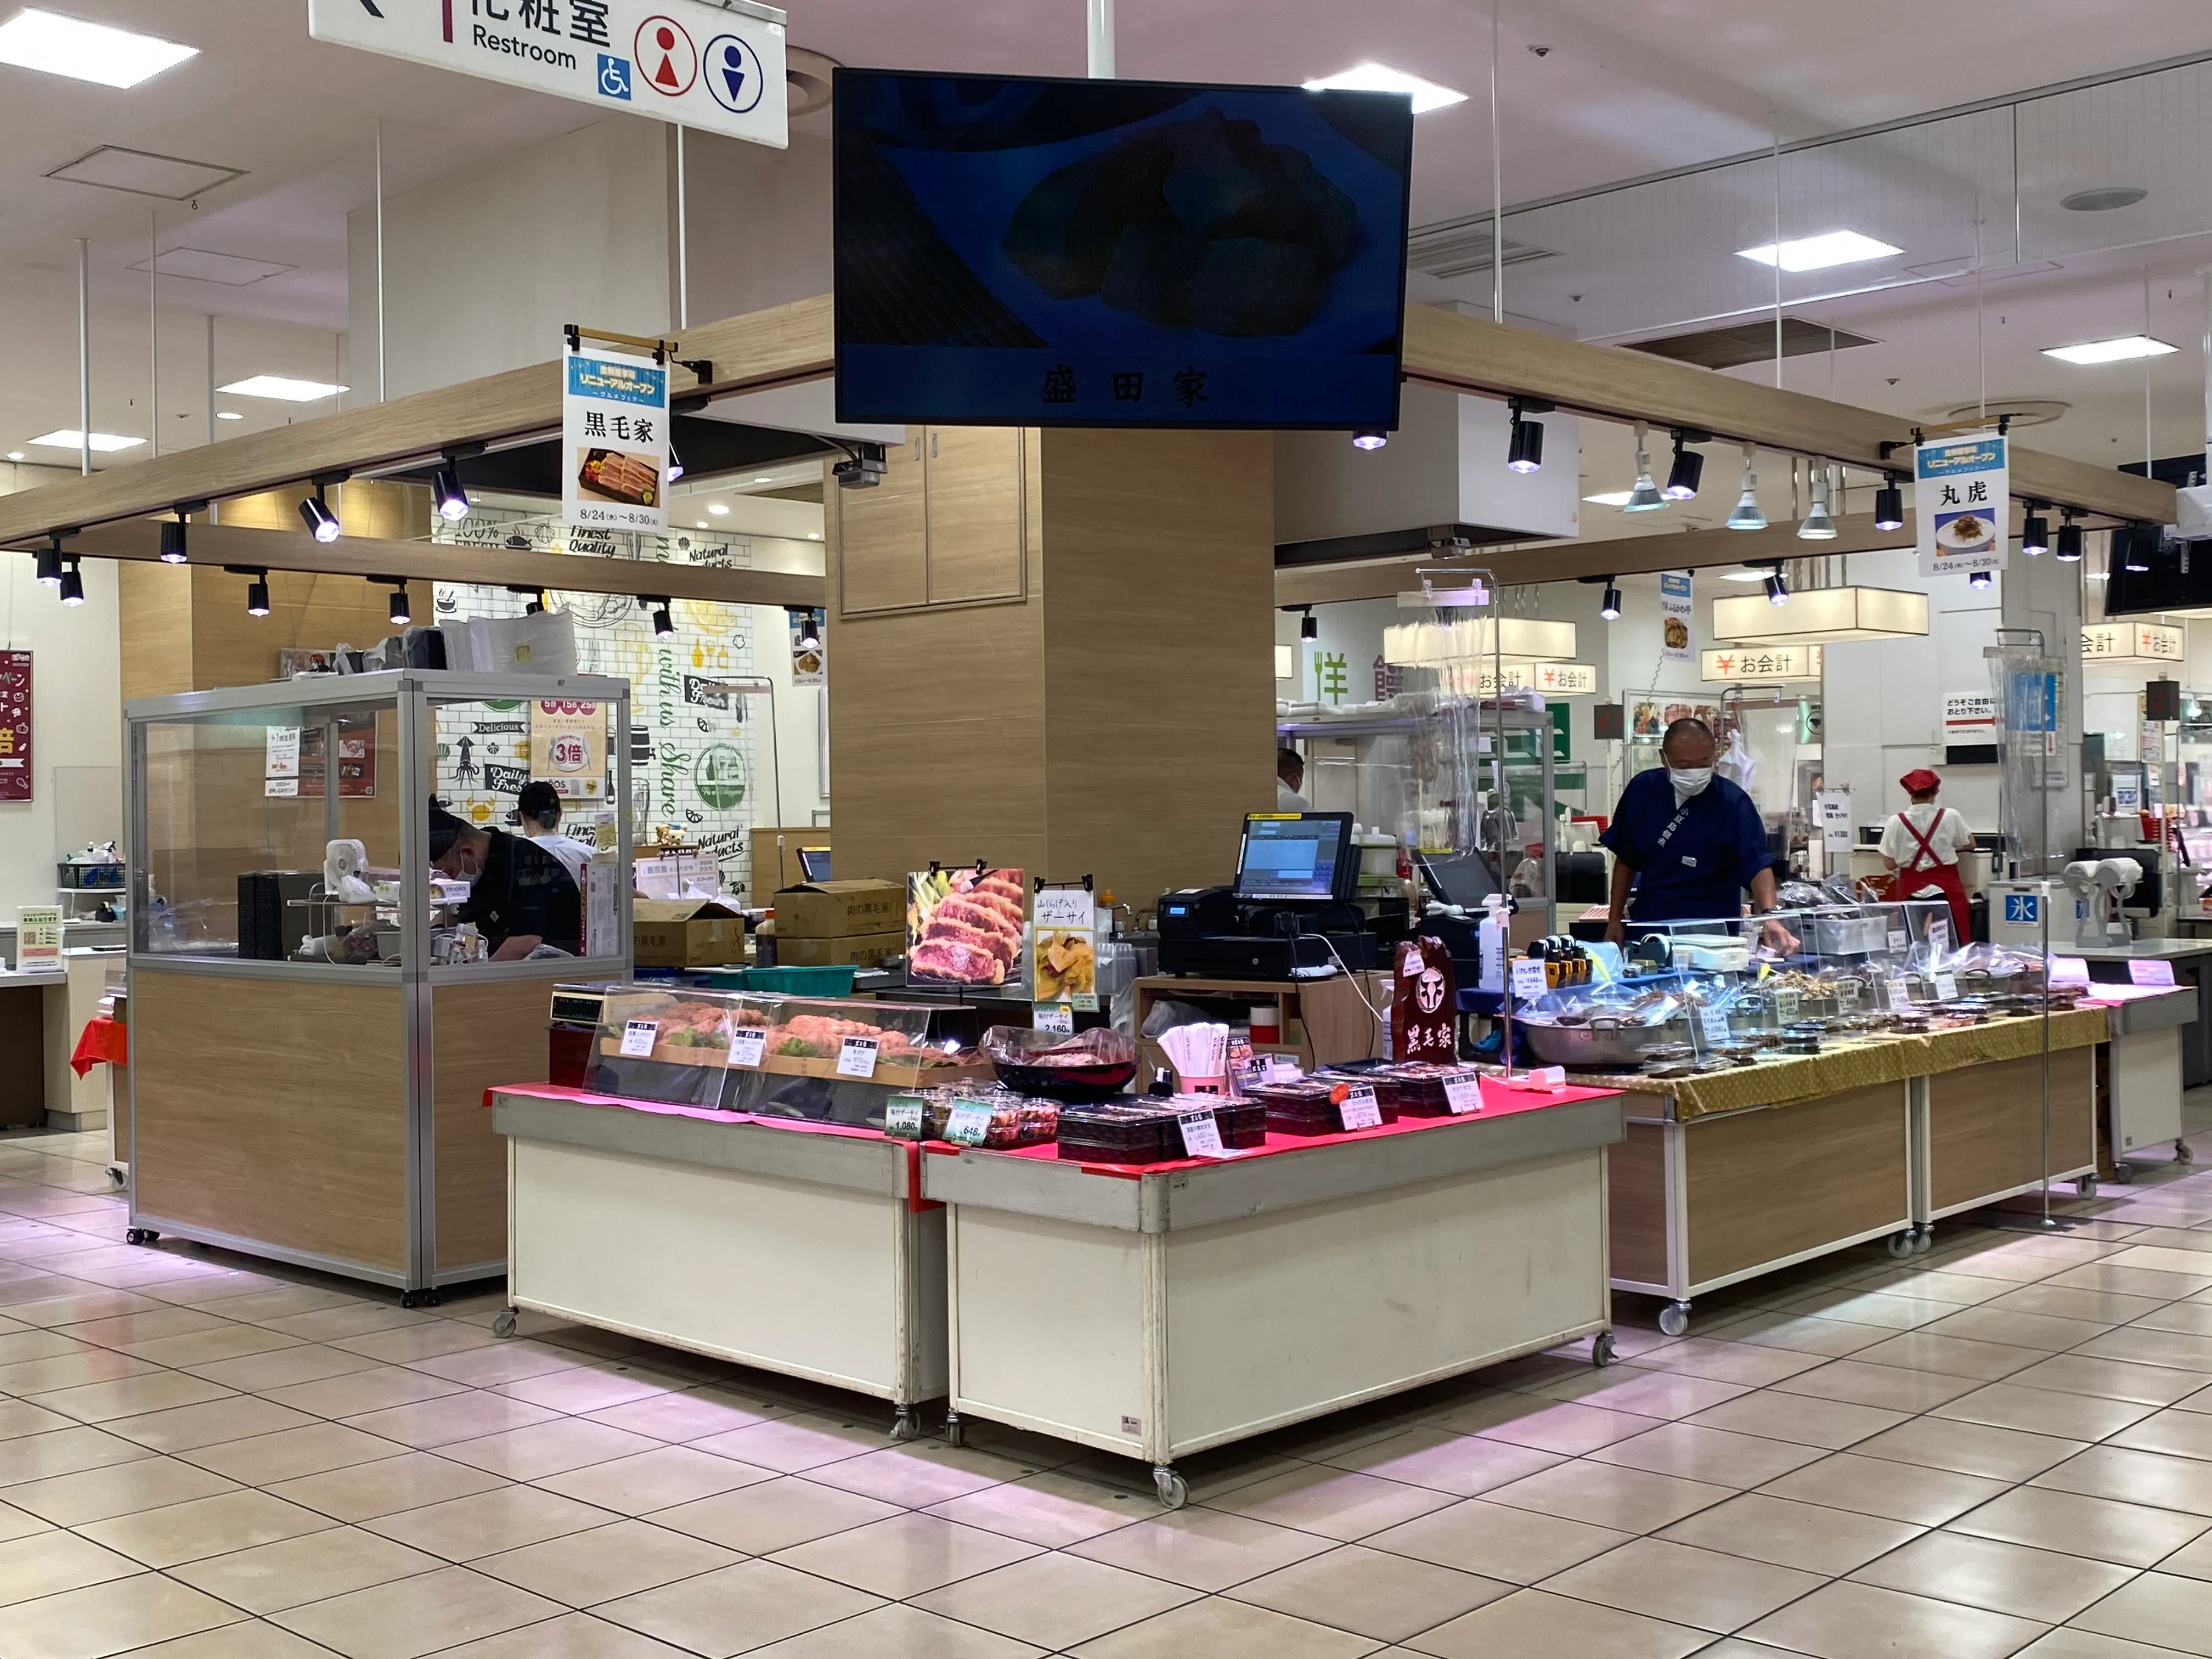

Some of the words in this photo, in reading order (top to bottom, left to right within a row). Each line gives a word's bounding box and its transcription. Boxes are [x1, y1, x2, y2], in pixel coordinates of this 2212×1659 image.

[472, 25, 577, 71] Restroom
[1042, 363, 1209, 408] 盛田家
[585, 411, 653, 443] 黒毛家
[1940, 481, 1988, 506] 丸虎
[571, 525, 612, 540] Finest
[569, 539, 616, 558] Quality
[690, 543, 728, 562] Natural
[659, 648, 682, 698] with
[1324, 652, 1348, 706] 洋
[479, 723, 519, 732] Delicious
[659, 702, 675, 729] us
[555, 743, 583, 764] 3倍
[490, 766, 527, 785] Daily
[492, 778, 524, 792] Fres
[658, 742, 691, 817] Share
[698, 826, 740, 850] Natural
[1037, 899, 1077, 909] 山くらげ入り
[2010, 896, 2035, 921] 氷
[1041, 911, 1086, 925] ザーサイ
[1407, 1022, 1452, 1054] 黒毛家
